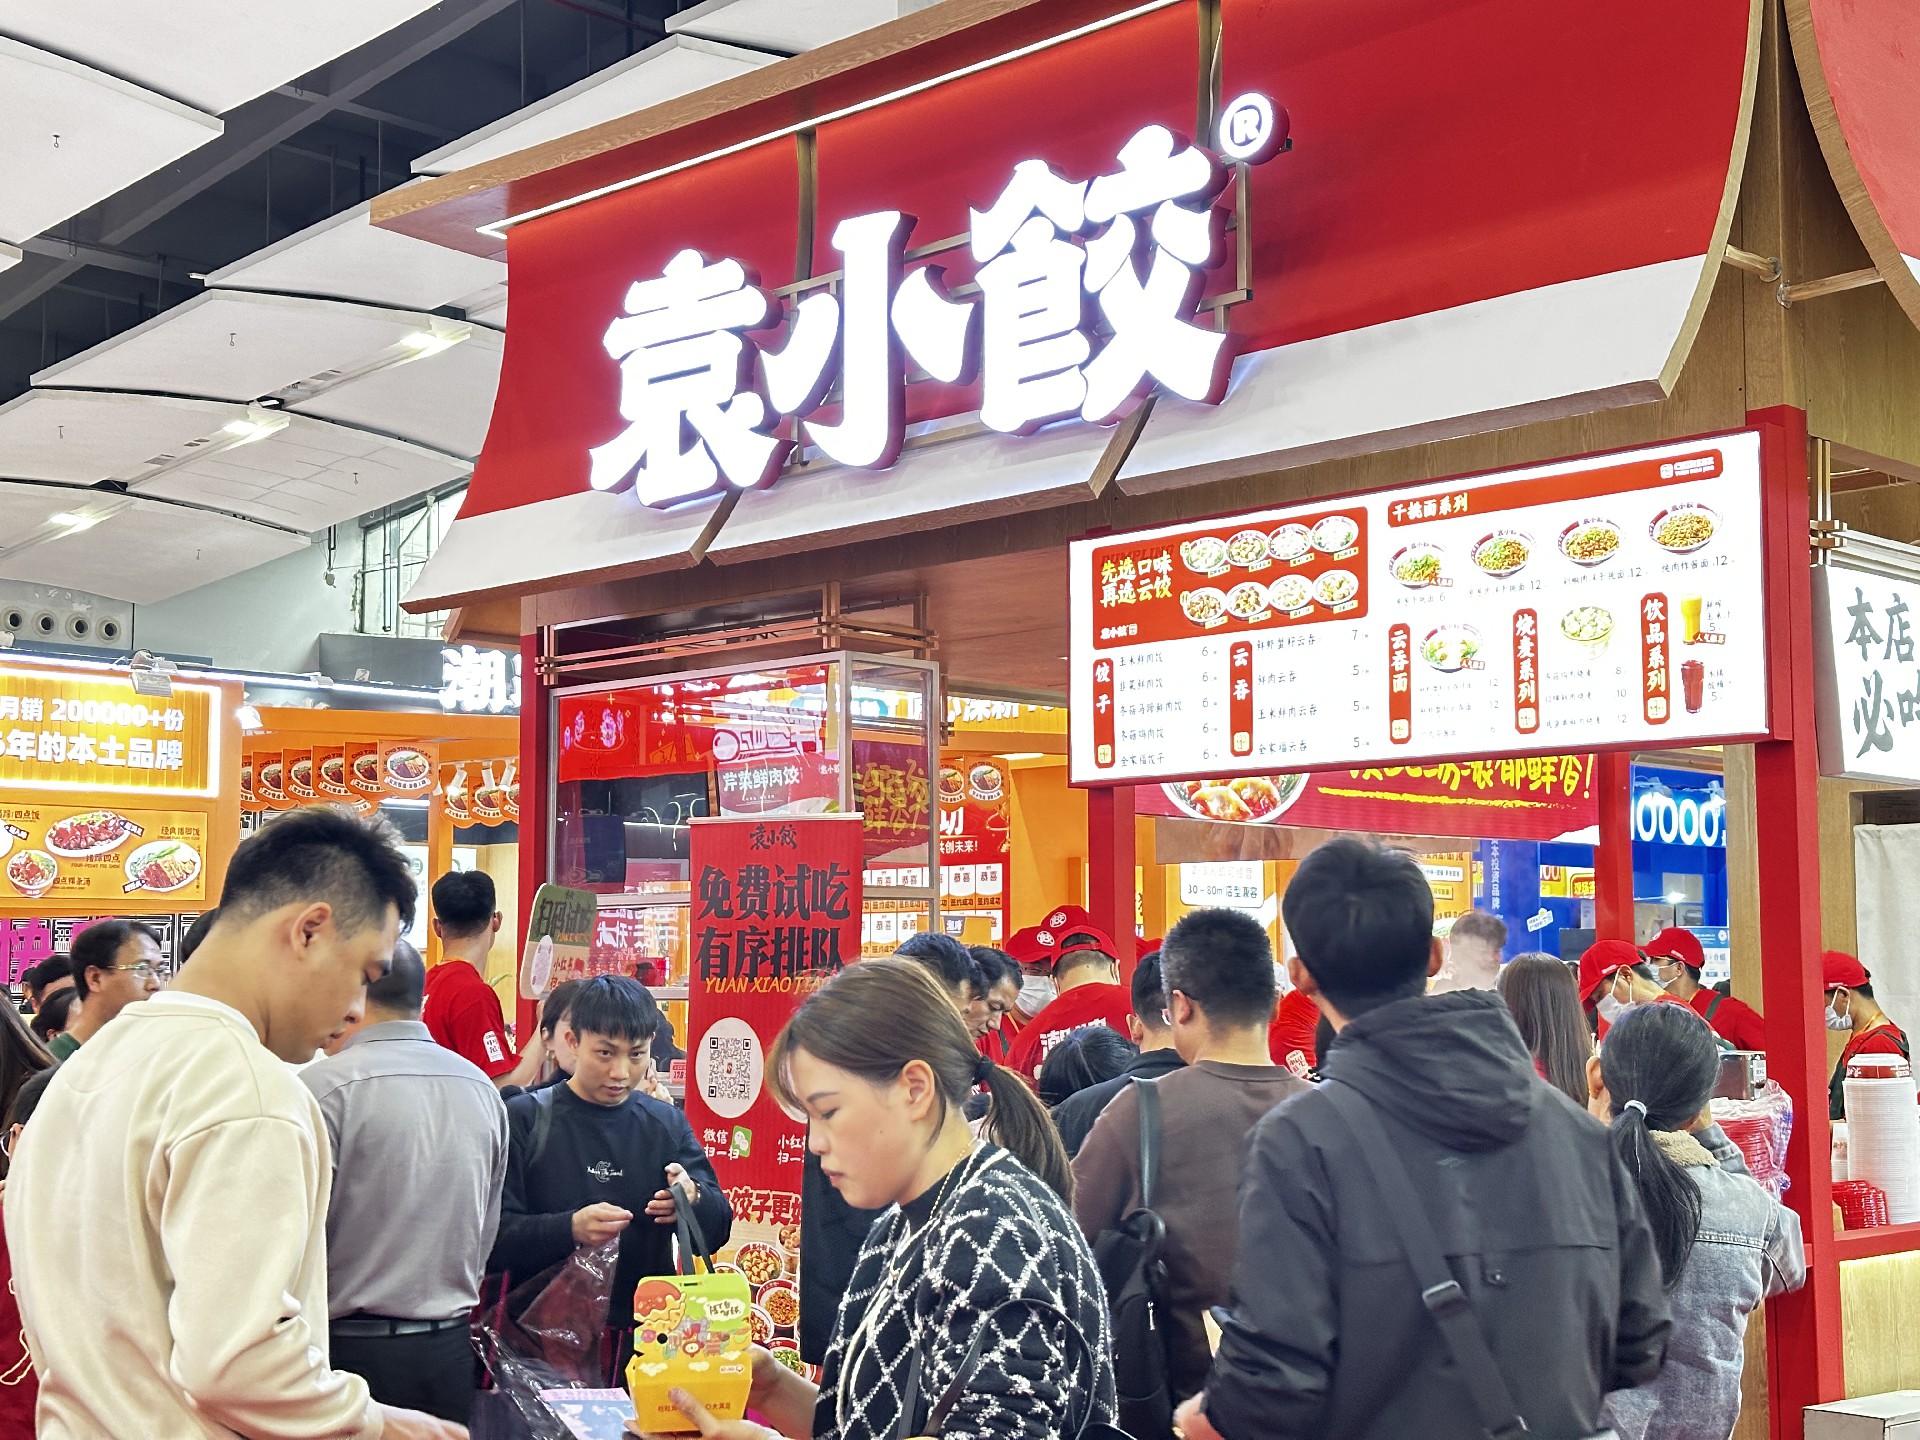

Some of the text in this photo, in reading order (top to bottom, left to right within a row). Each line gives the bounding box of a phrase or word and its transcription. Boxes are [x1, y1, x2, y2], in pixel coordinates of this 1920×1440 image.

[589, 123, 1228, 508] 袁小饺
[1100, 549, 1174, 586] 先选口味
[1100, 573, 1174, 608] 再选云饺
[1844, 586, 1915, 663] 本店
[1202, 647, 1208, 657] 6
[1515, 613, 1537, 703] 烧麦系列
[1643, 598, 1667, 693] 饮品系列
[1202, 672, 1209, 682] 6
[1233, 648, 1250, 700] 云吞
[1352, 665, 1360, 676] 5
[1391, 630, 1409, 693] 云吞面
[440, 645, 521, 713] 潮
[1095, 662, 1111, 714] 饺子
[0, 696, 184, 732] 月销 200000+份
[1203, 698, 1209, 708] 6
[1353, 701, 1360, 711] 5
[1203, 723, 1209, 733] 6
[1353, 737, 1360, 748] 5
[1203, 749, 1210, 759] 6
[723, 765, 800, 793] 芹菜鲜肉饺
[696, 862, 850, 922] 免费试吃
[694, 924, 846, 984] 有序排队
[705, 977, 748, 994] YUAN
[750, 977, 791, 993] XIAO
[703, 1128, 728, 1145] 微信
[704, 1143, 740, 1161] 扫一扫
[777, 1149, 804, 1165] 扫一
